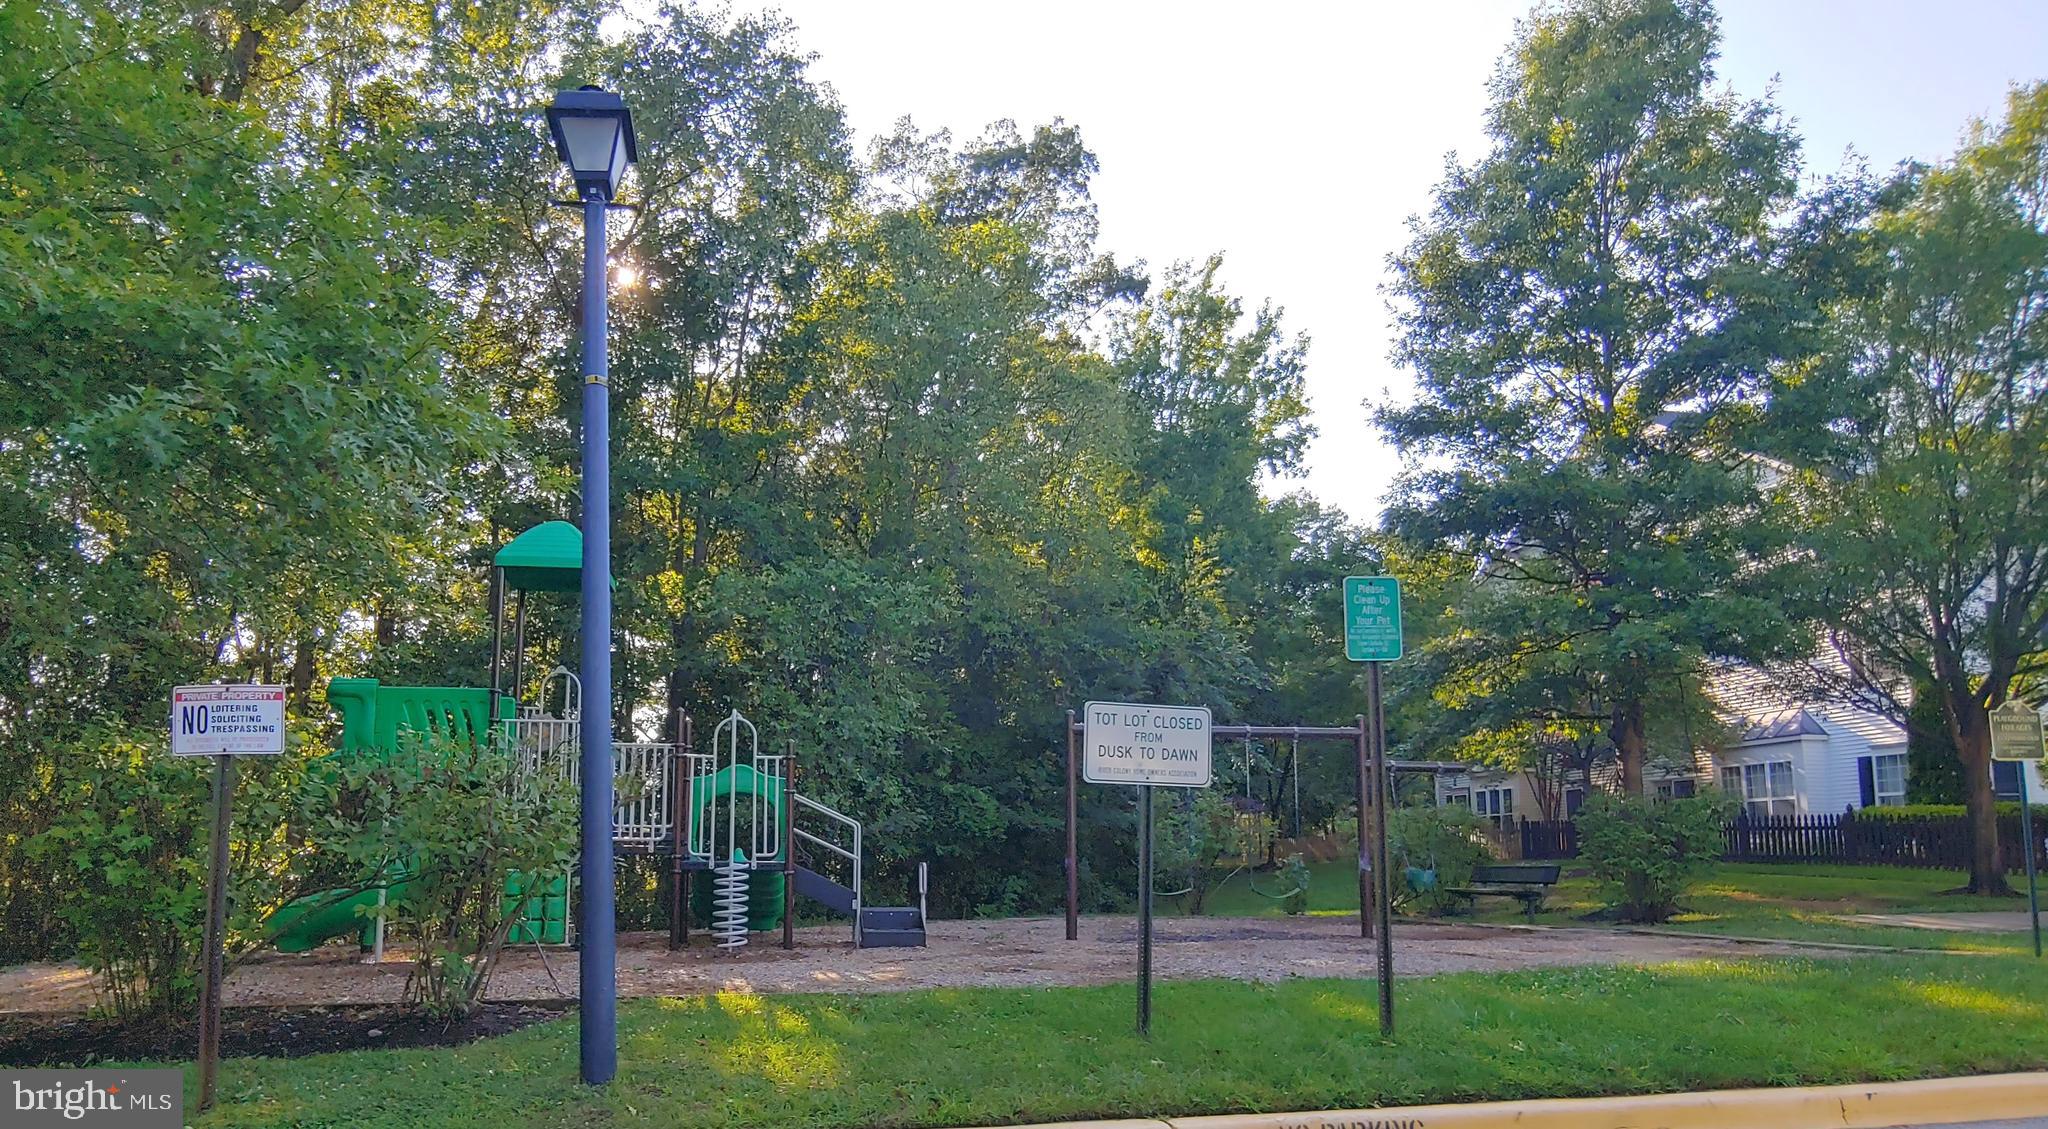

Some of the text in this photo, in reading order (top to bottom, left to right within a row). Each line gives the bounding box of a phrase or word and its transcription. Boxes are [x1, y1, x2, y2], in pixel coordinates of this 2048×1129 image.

[1358, 585, 1385, 594] Please
[1353, 595, 1391, 606] Clean Up
[1362, 605, 1382, 614] After
[1355, 616, 1391, 625] Your Pet
[181, 692, 276, 701] PRIVATE PROPERTY
[211, 704, 258, 713] LOITERING
[182, 705, 208, 735] NO
[211, 715, 262, 724] SOLICITING
[1095, 712, 1203, 731] TOT LOT CLOSED
[211, 725, 275, 733] TRESPASSING
[1134, 732, 1163, 743] FROM
[1098, 745, 1198, 762] DUSK TO DAWN
